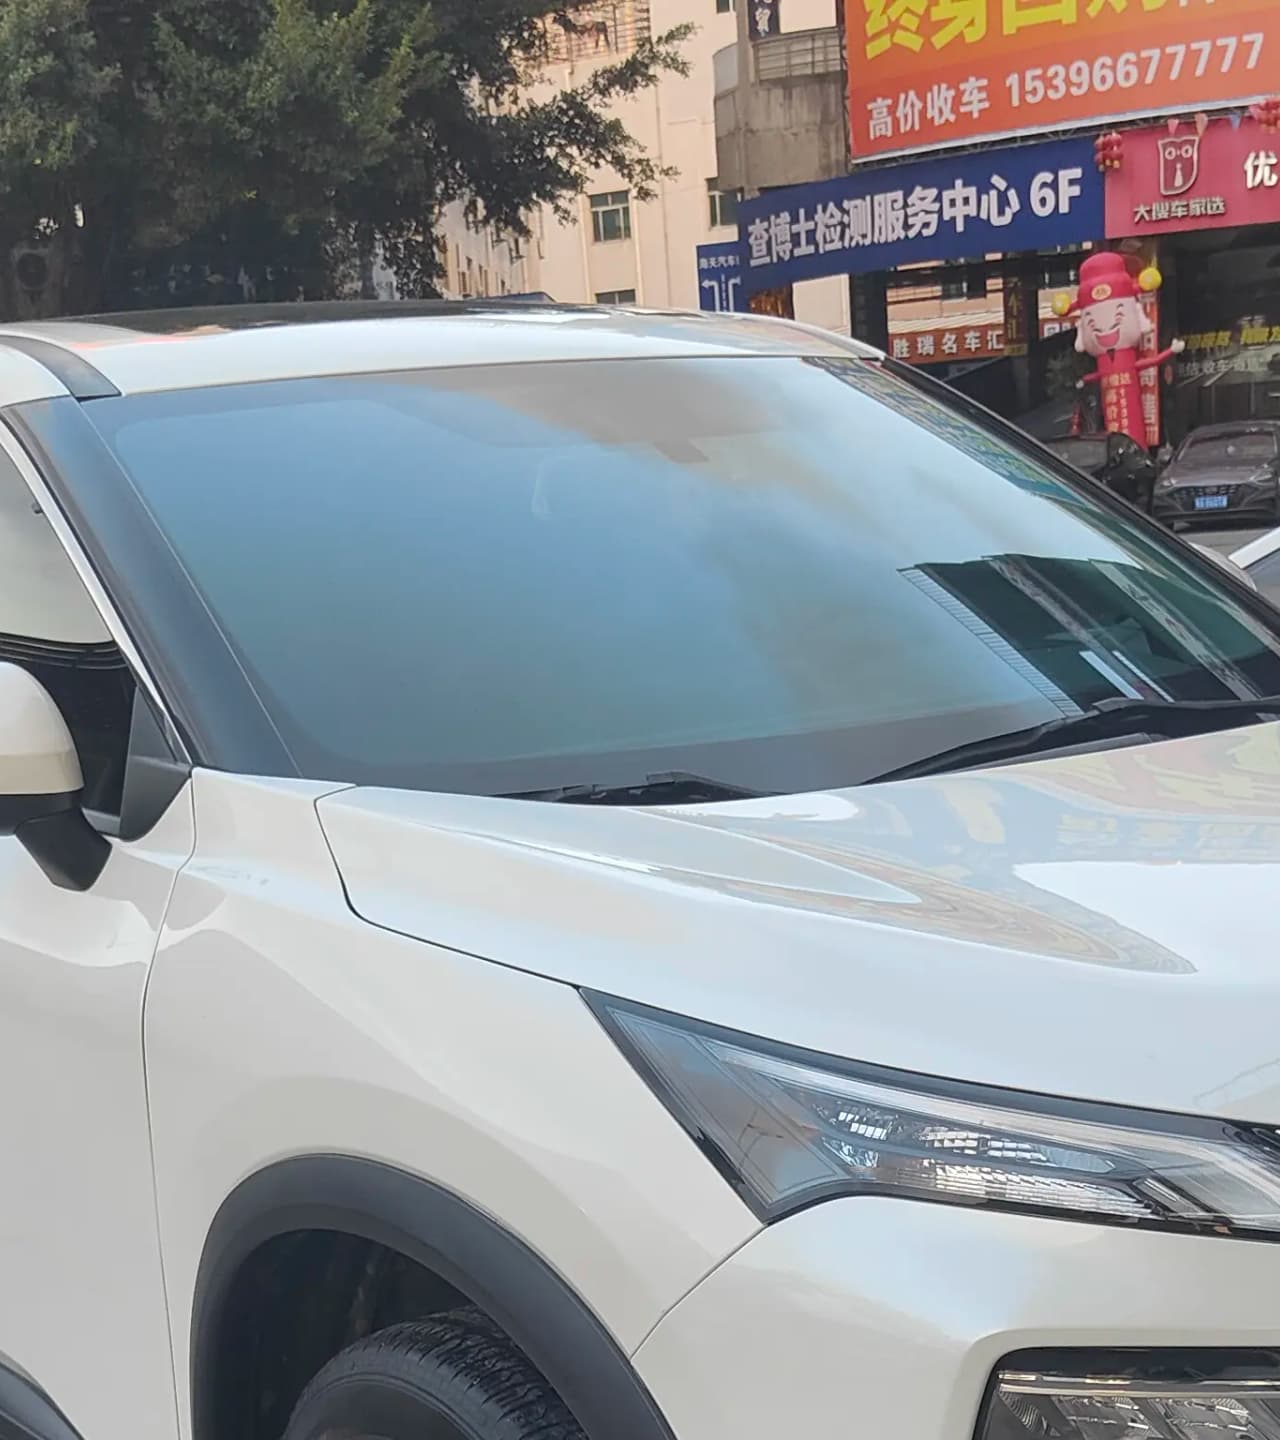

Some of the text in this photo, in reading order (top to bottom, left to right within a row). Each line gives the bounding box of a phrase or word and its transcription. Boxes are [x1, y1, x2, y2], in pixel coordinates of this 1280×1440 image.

[867, 76, 991, 140] 高价收车
[1005, 32, 1265, 107] 15396677777
[748, 167, 1083, 268] 查博士检测服务中心 6F
[1133, 196, 1227, 224] 大搜车家选
